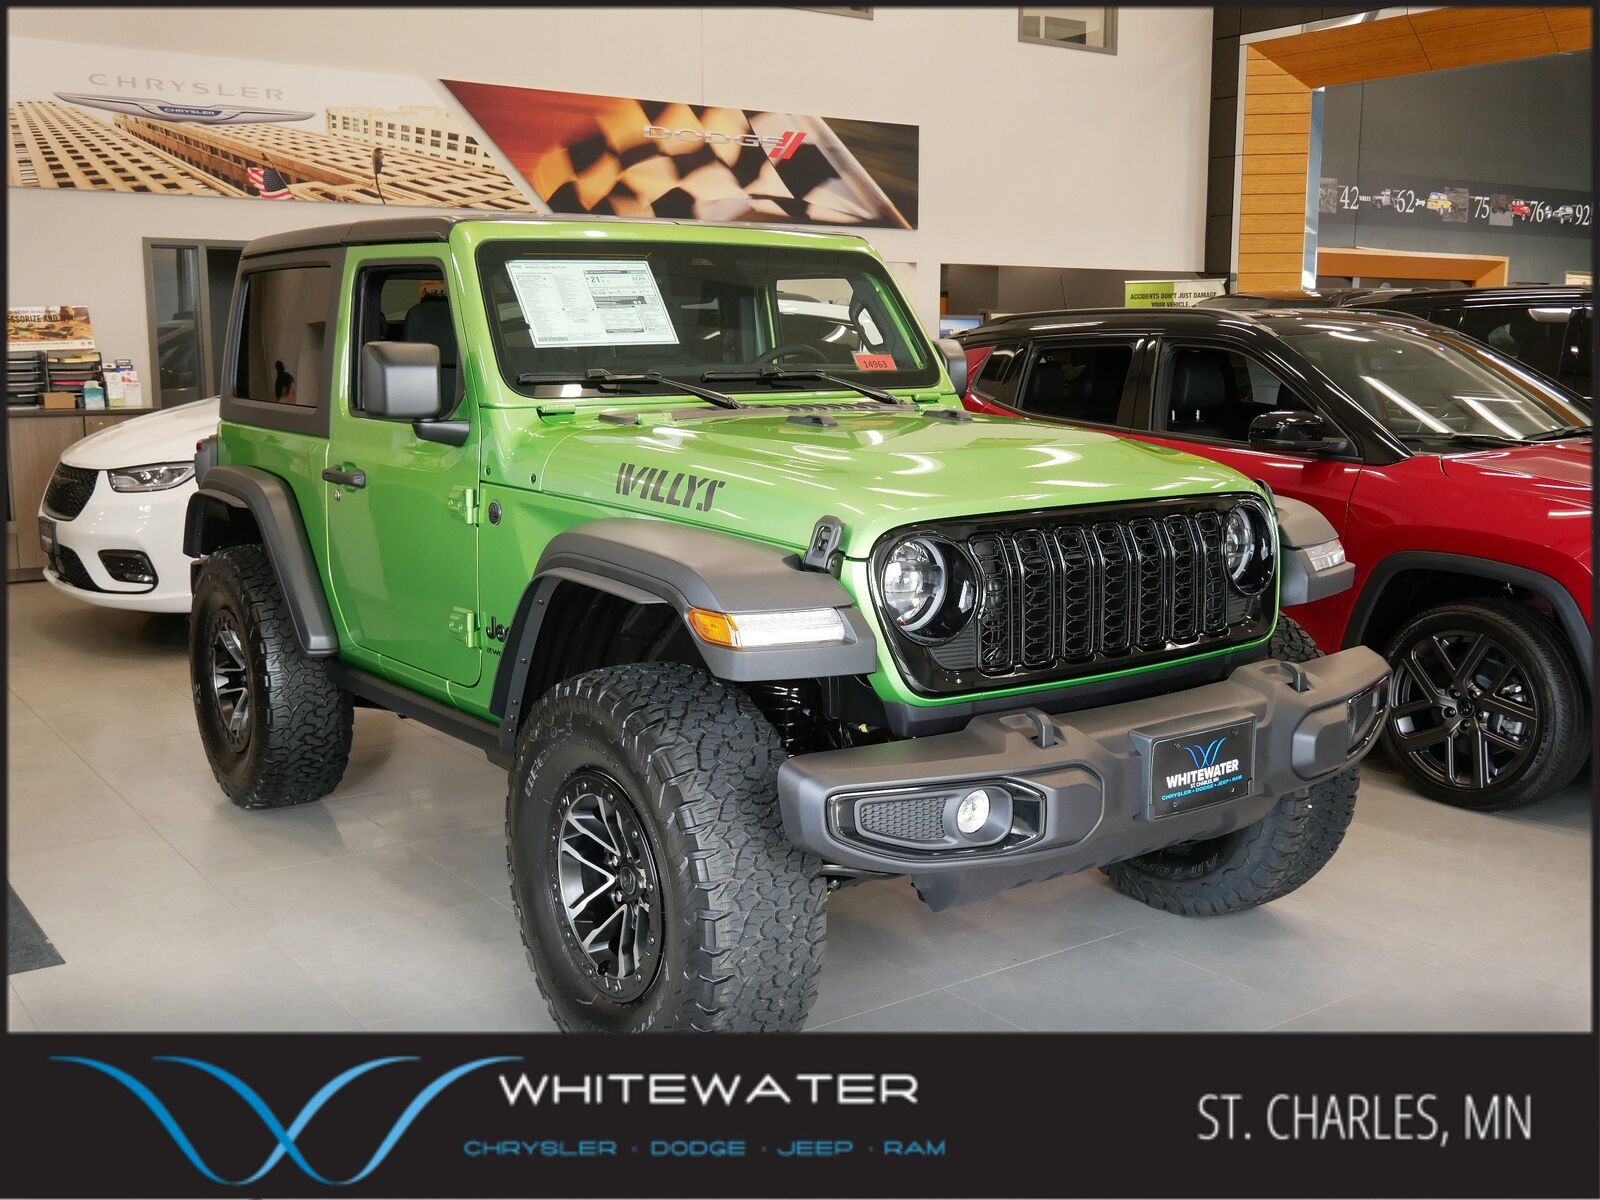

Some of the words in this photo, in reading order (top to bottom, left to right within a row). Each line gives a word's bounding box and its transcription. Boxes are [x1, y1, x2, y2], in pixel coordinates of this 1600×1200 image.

[88, 73, 283, 101] CHRYSLER
[164, 107, 215, 116] CHRYSLER
[643, 125, 784, 149] DODGE
[1339, 185, 1360, 210] 42
[1396, 189, 1415, 213] 62
[1474, 196, 1490, 219] 75
[1529, 201, 1545, 223] 76
[1575, 204, 1590, 226] 92
[1130, 292, 1160, 300] ACCIDENTS
[1160, 292, 1177, 300] DON'T
[8, 314, 42, 323] SSORIZE
[863, 360, 888, 369] 14963
[615, 462, 727, 512] WILLYS
[1166, 758, 1239, 789] WHITEWATER
[1161, 788, 1192, 801] CHRYSLER
[1195, 783, 1214, 793] DODGE
[1231, 774, 1243, 782] RAM
